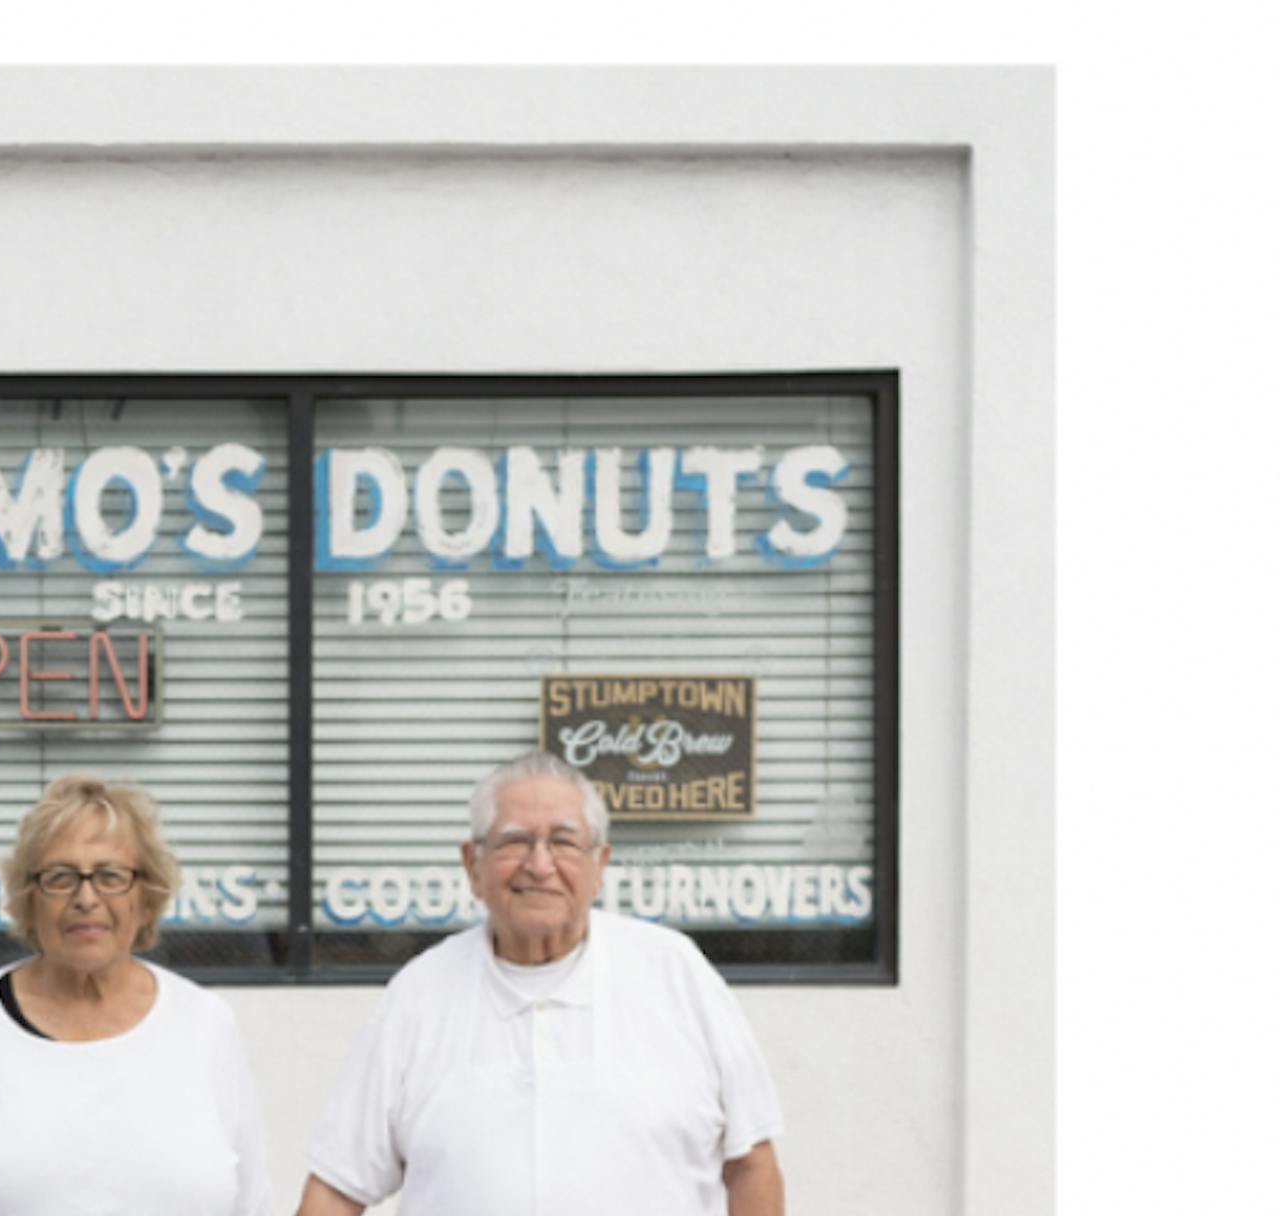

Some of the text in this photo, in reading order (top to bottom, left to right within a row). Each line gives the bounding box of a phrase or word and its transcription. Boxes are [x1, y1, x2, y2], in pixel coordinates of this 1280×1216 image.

[315, 445, 849, 570] DONUTS
[91, 578, 471, 625] SINCE 1956
[549, 679, 745, 717] STUMPTOWN
[559, 719, 734, 767] Cold Brew
[669, 771, 746, 810] HERE
[603, 864, 873, 926] TURNOVERS
